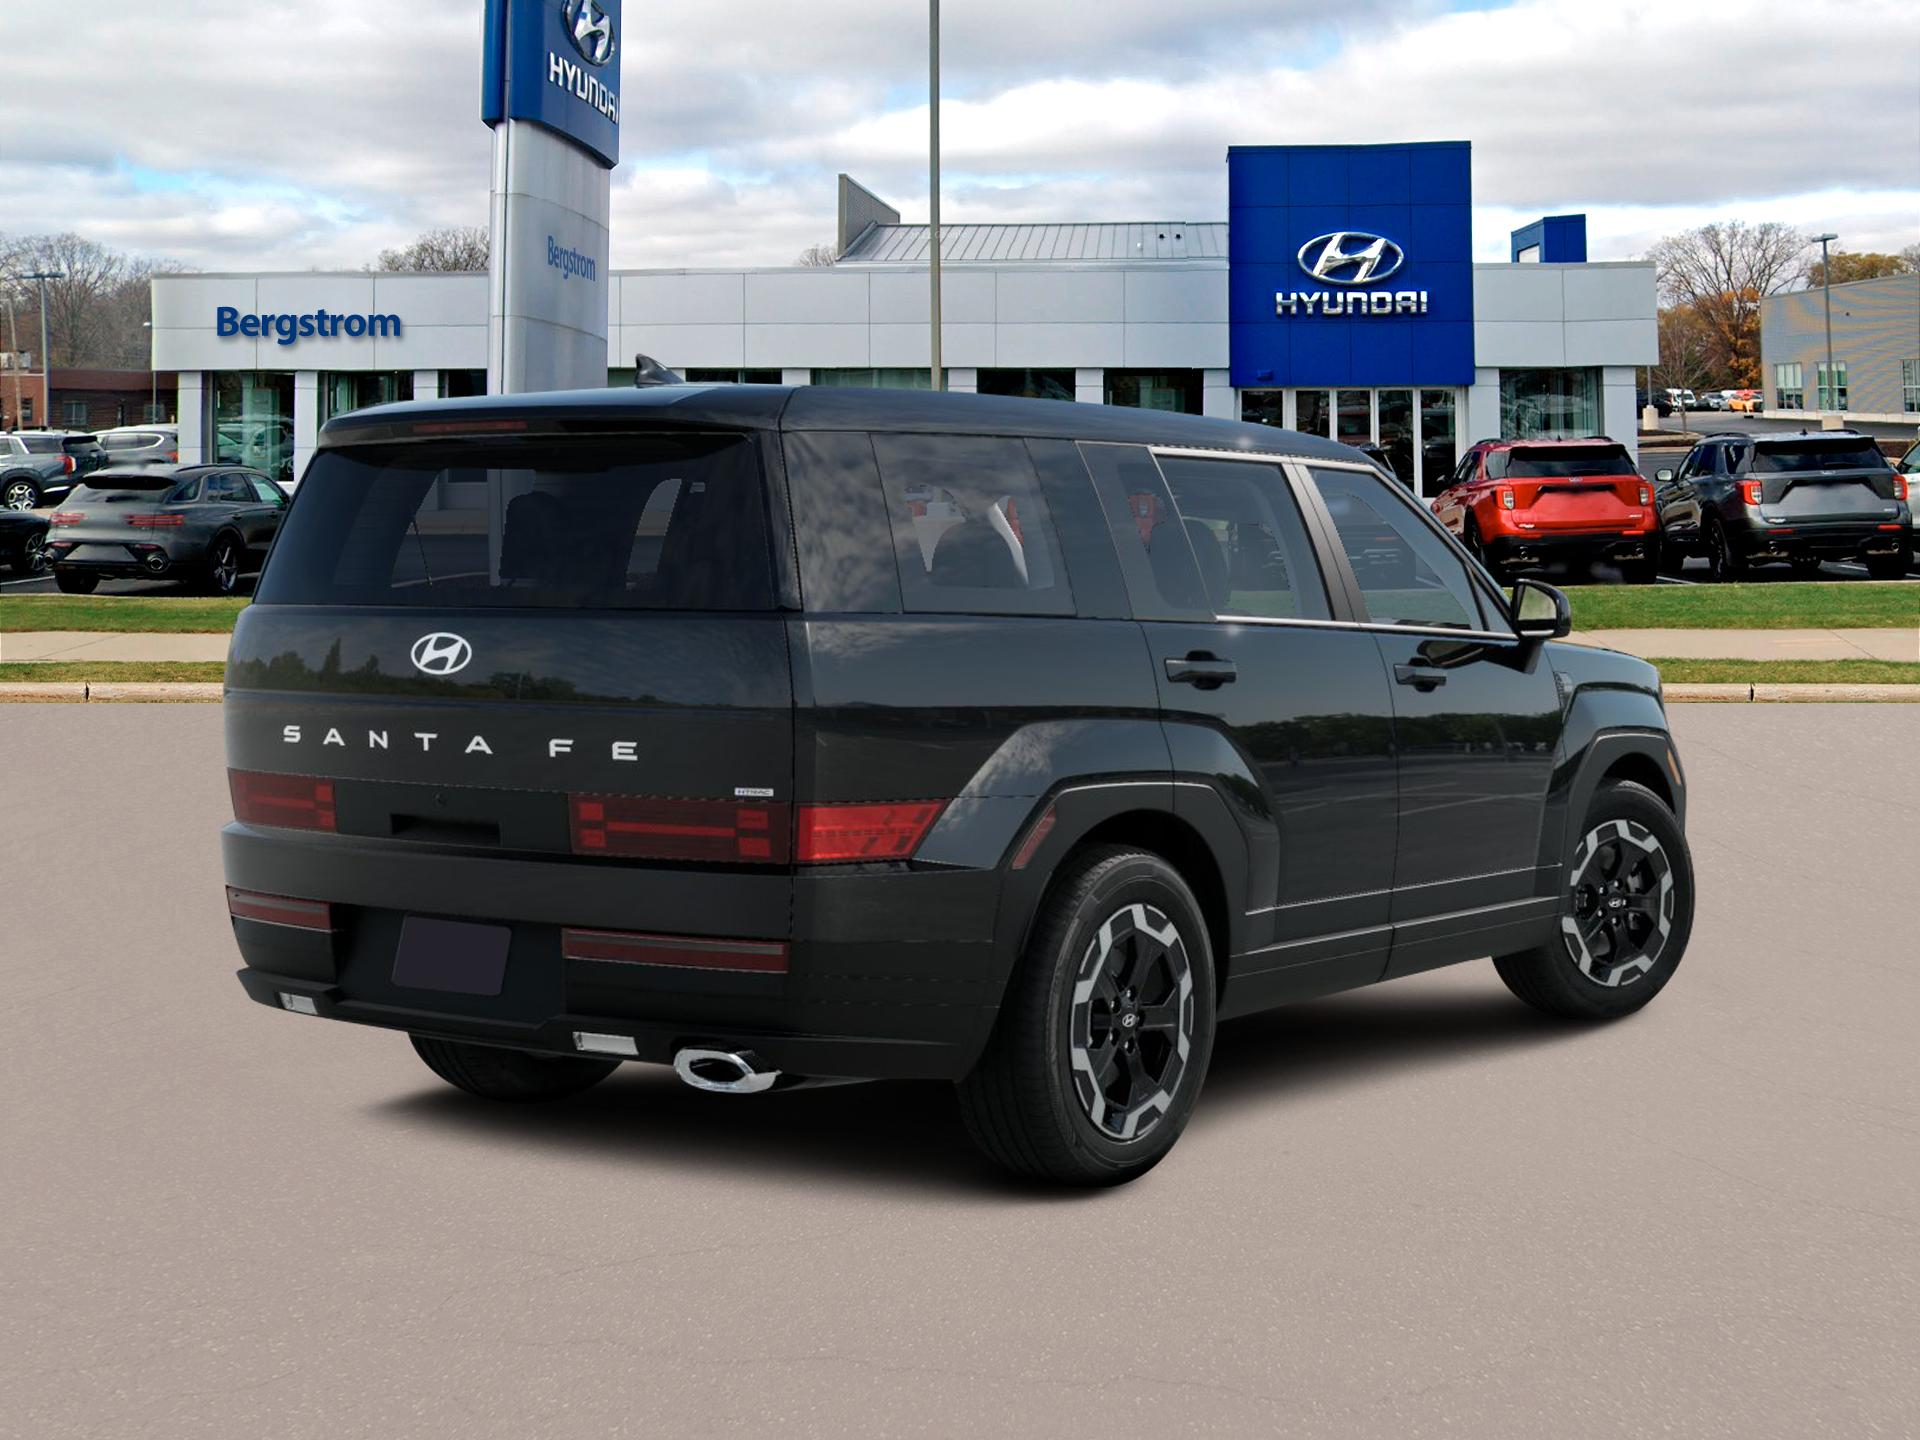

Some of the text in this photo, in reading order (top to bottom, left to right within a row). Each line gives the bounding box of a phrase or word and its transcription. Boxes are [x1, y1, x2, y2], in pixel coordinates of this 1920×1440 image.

[549, 51, 619, 124] HYUNDAI
[547, 235, 596, 281] Bergstrom
[1275, 290, 1428, 315] HYUNDAI
[216, 306, 401, 345] Bergstrom
[283, 725, 638, 761] SANTA FE
